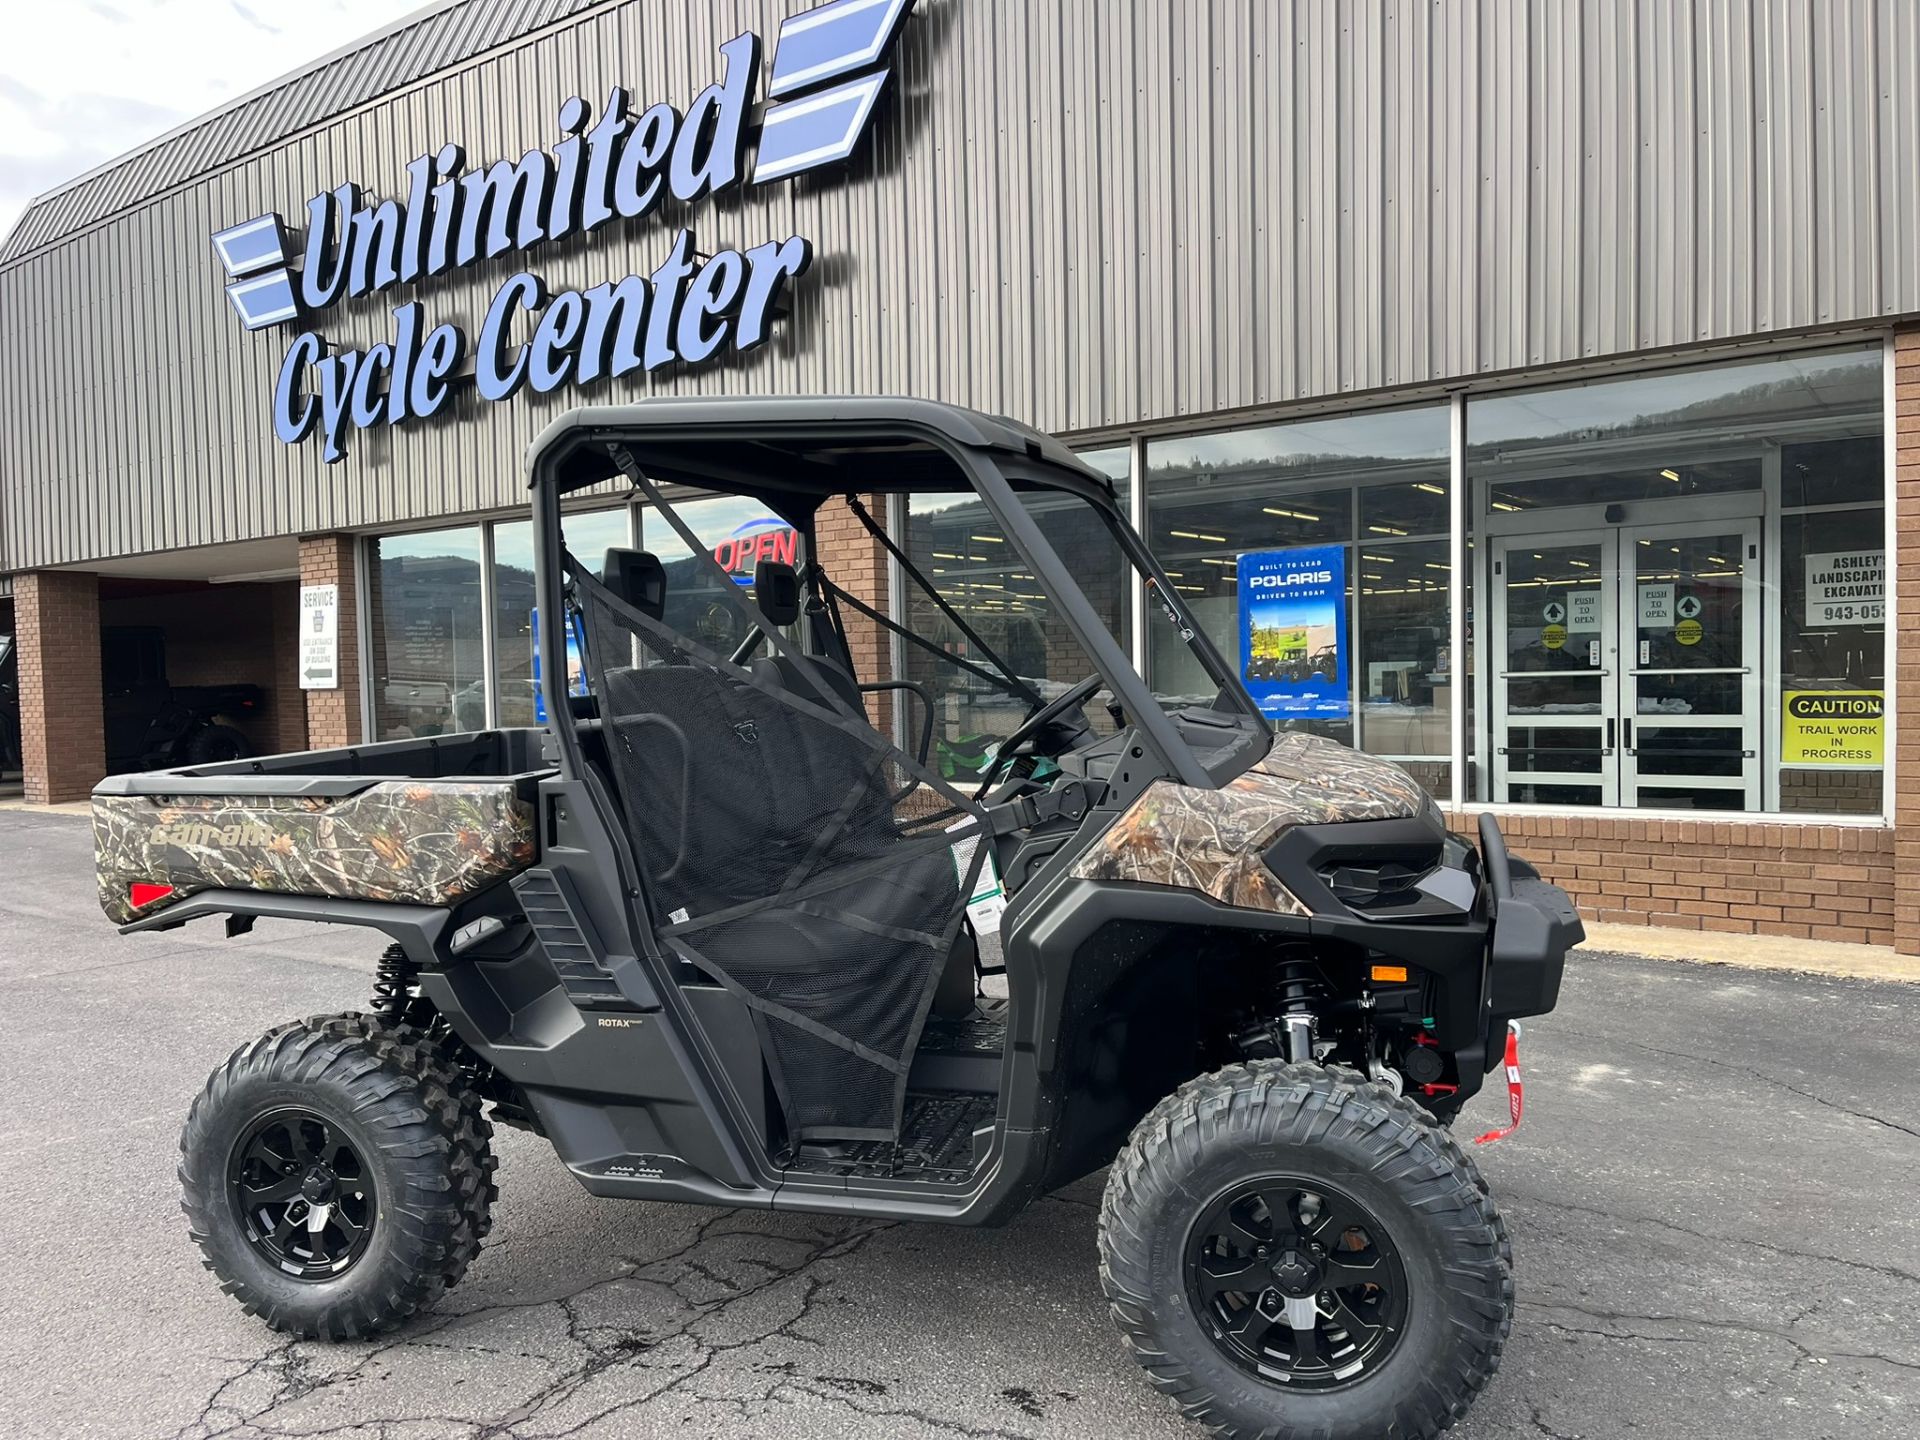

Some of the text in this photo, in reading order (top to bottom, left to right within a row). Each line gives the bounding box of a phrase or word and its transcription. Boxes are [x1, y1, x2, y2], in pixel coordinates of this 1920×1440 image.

[302, 31, 757, 308] Unlimited
[274, 228, 812, 464] Cycle Center
[714, 529, 798, 573] OPEN
[1259, 560, 1322, 571] BUILT TO LEAD
[1833, 555, 1885, 569] ASHLEY'
[1250, 571, 1332, 588] POLARIS
[1256, 592, 1286, 600] DRIVEN
[1824, 583, 1885, 598] EXCAVATI
[304, 591, 334, 608] SERVICE
[1574, 597, 1595, 605] PUSH
[1574, 616, 1595, 624] OPEN
[1646, 610, 1667, 618] OPEN
[1797, 700, 1881, 714] CAUTION
[1798, 725, 1877, 735] TRAIL WORK
[1831, 738, 1843, 747] IN
[1802, 749, 1872, 759] PROGRESS
[149, 822, 273, 847] can-am
[598, 1018, 630, 1028] ROTAX
